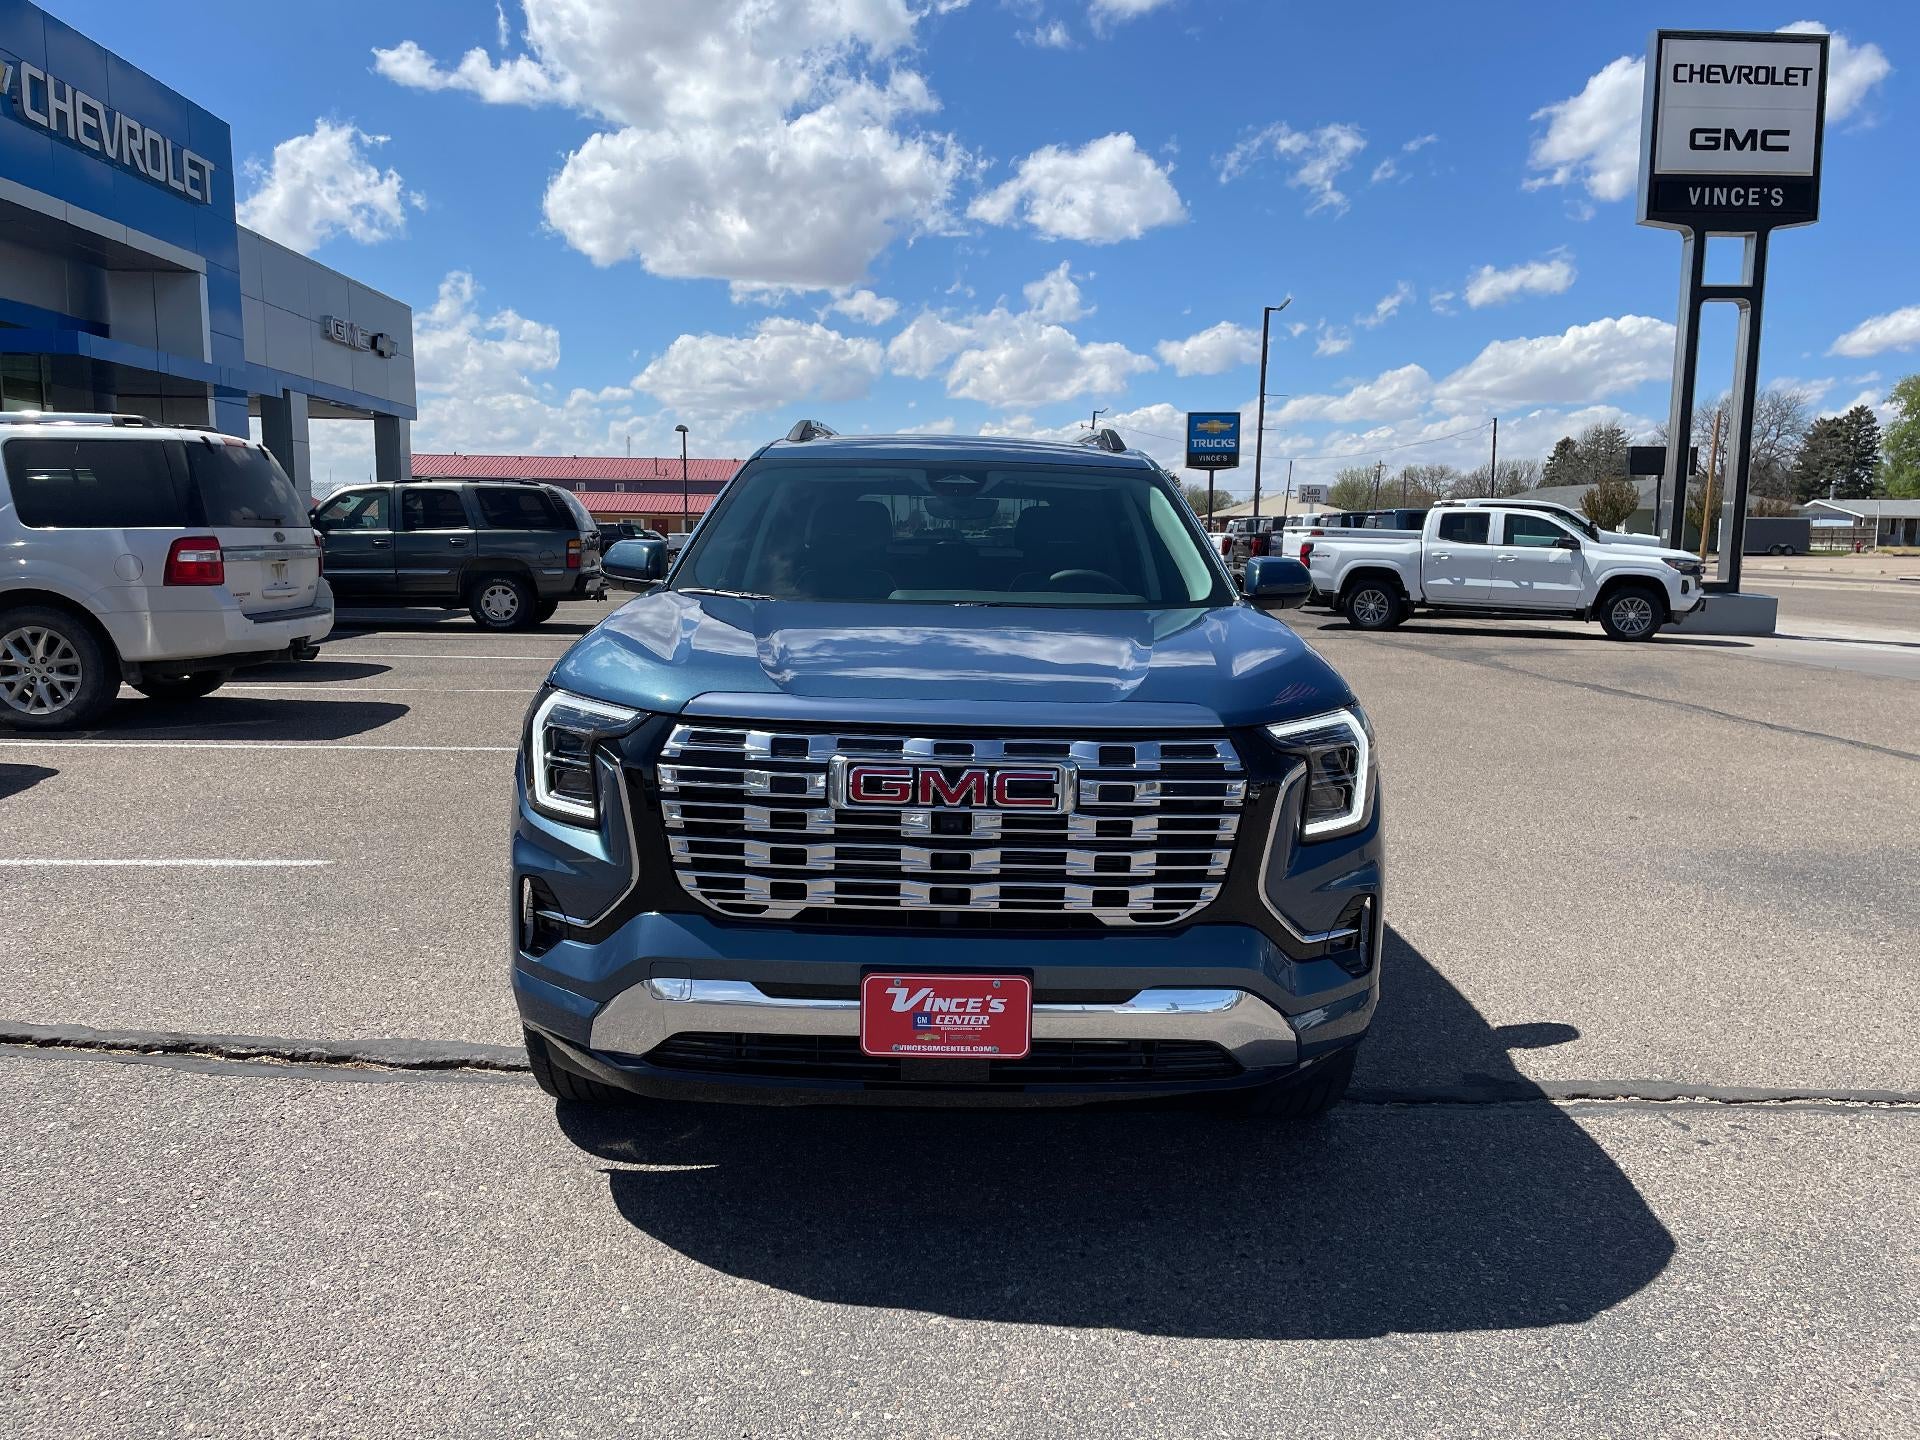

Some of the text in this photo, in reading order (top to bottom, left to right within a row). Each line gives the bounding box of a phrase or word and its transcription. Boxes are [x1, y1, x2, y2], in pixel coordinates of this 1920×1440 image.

[1672, 63, 1813, 87] CHEVROLET
[20, 61, 215, 204] CHEVROLET
[1689, 128, 1790, 152] GMC
[1689, 187, 1784, 206] VINCE'S
[327, 315, 371, 352] GMC
[1191, 438, 1236, 448] TRUCKS
[850, 766, 1058, 808] GMC
[917, 1015, 990, 1025] GM CENTER
